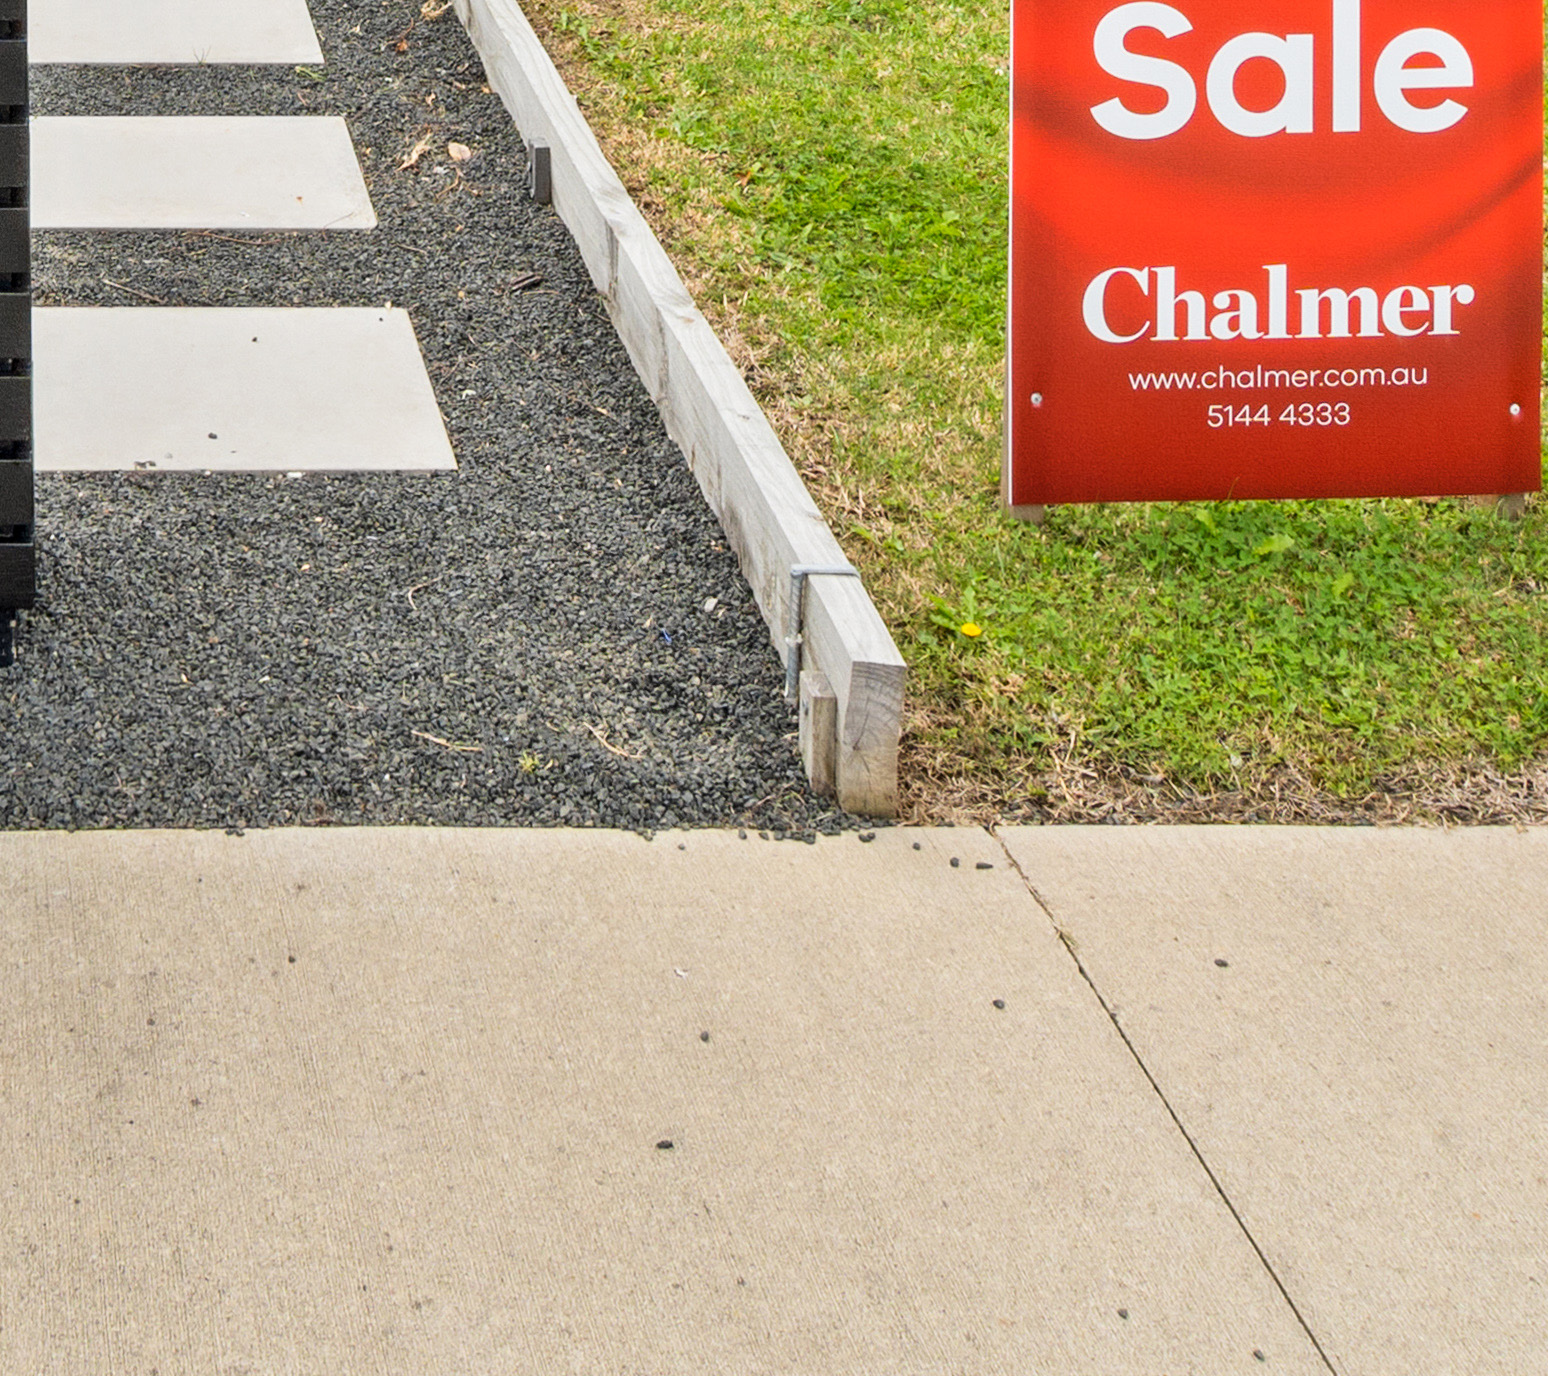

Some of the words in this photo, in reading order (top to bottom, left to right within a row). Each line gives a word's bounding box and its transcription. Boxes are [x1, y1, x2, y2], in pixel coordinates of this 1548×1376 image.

[1082, 264, 1475, 344] Chalmer
[1128, 363, 1428, 390] www.chalmer.com.au
[1207, 404, 1271, 428] 5144
[1278, 402, 1351, 427] 4333
